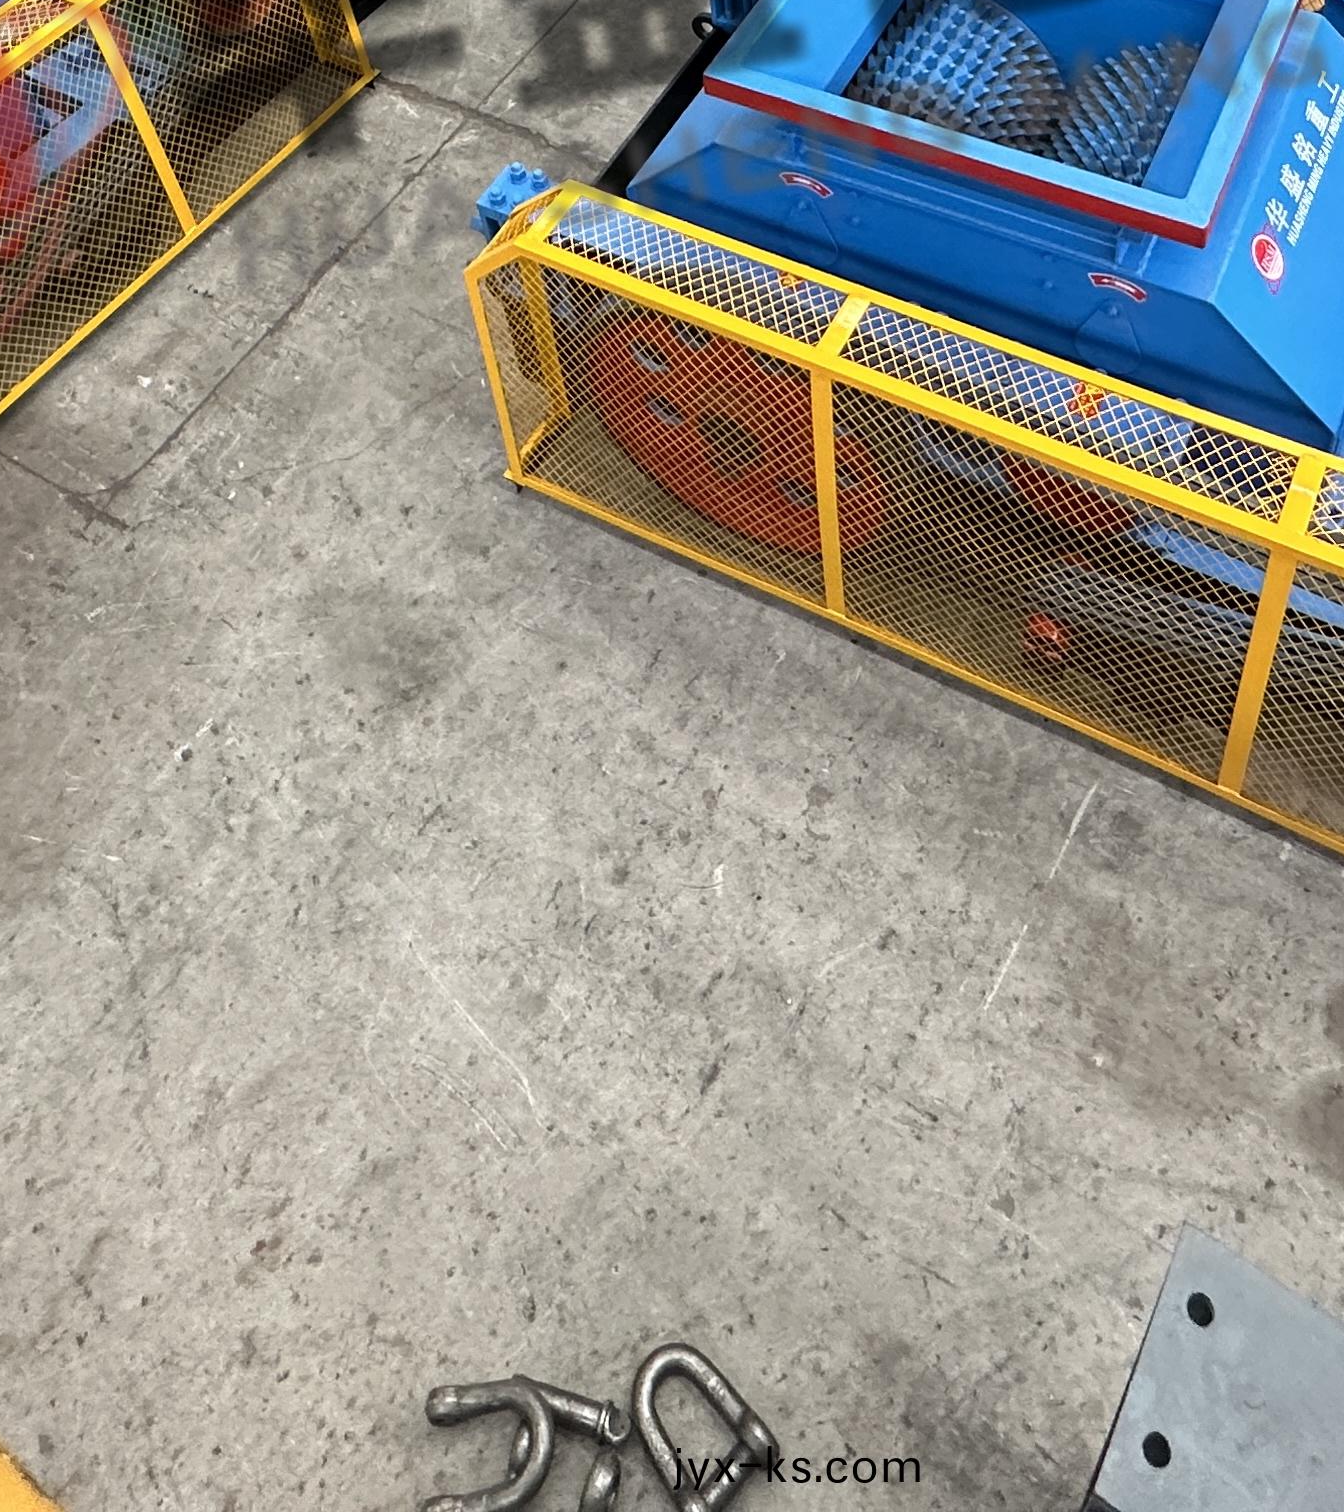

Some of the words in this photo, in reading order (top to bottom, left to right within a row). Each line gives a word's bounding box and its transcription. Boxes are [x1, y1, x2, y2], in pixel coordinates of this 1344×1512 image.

[1265, 71, 1340, 232] 华盛铭重工
[1286, 188, 1314, 247] HUASHENG
[1316, 132, 1334, 168] HEAVY
